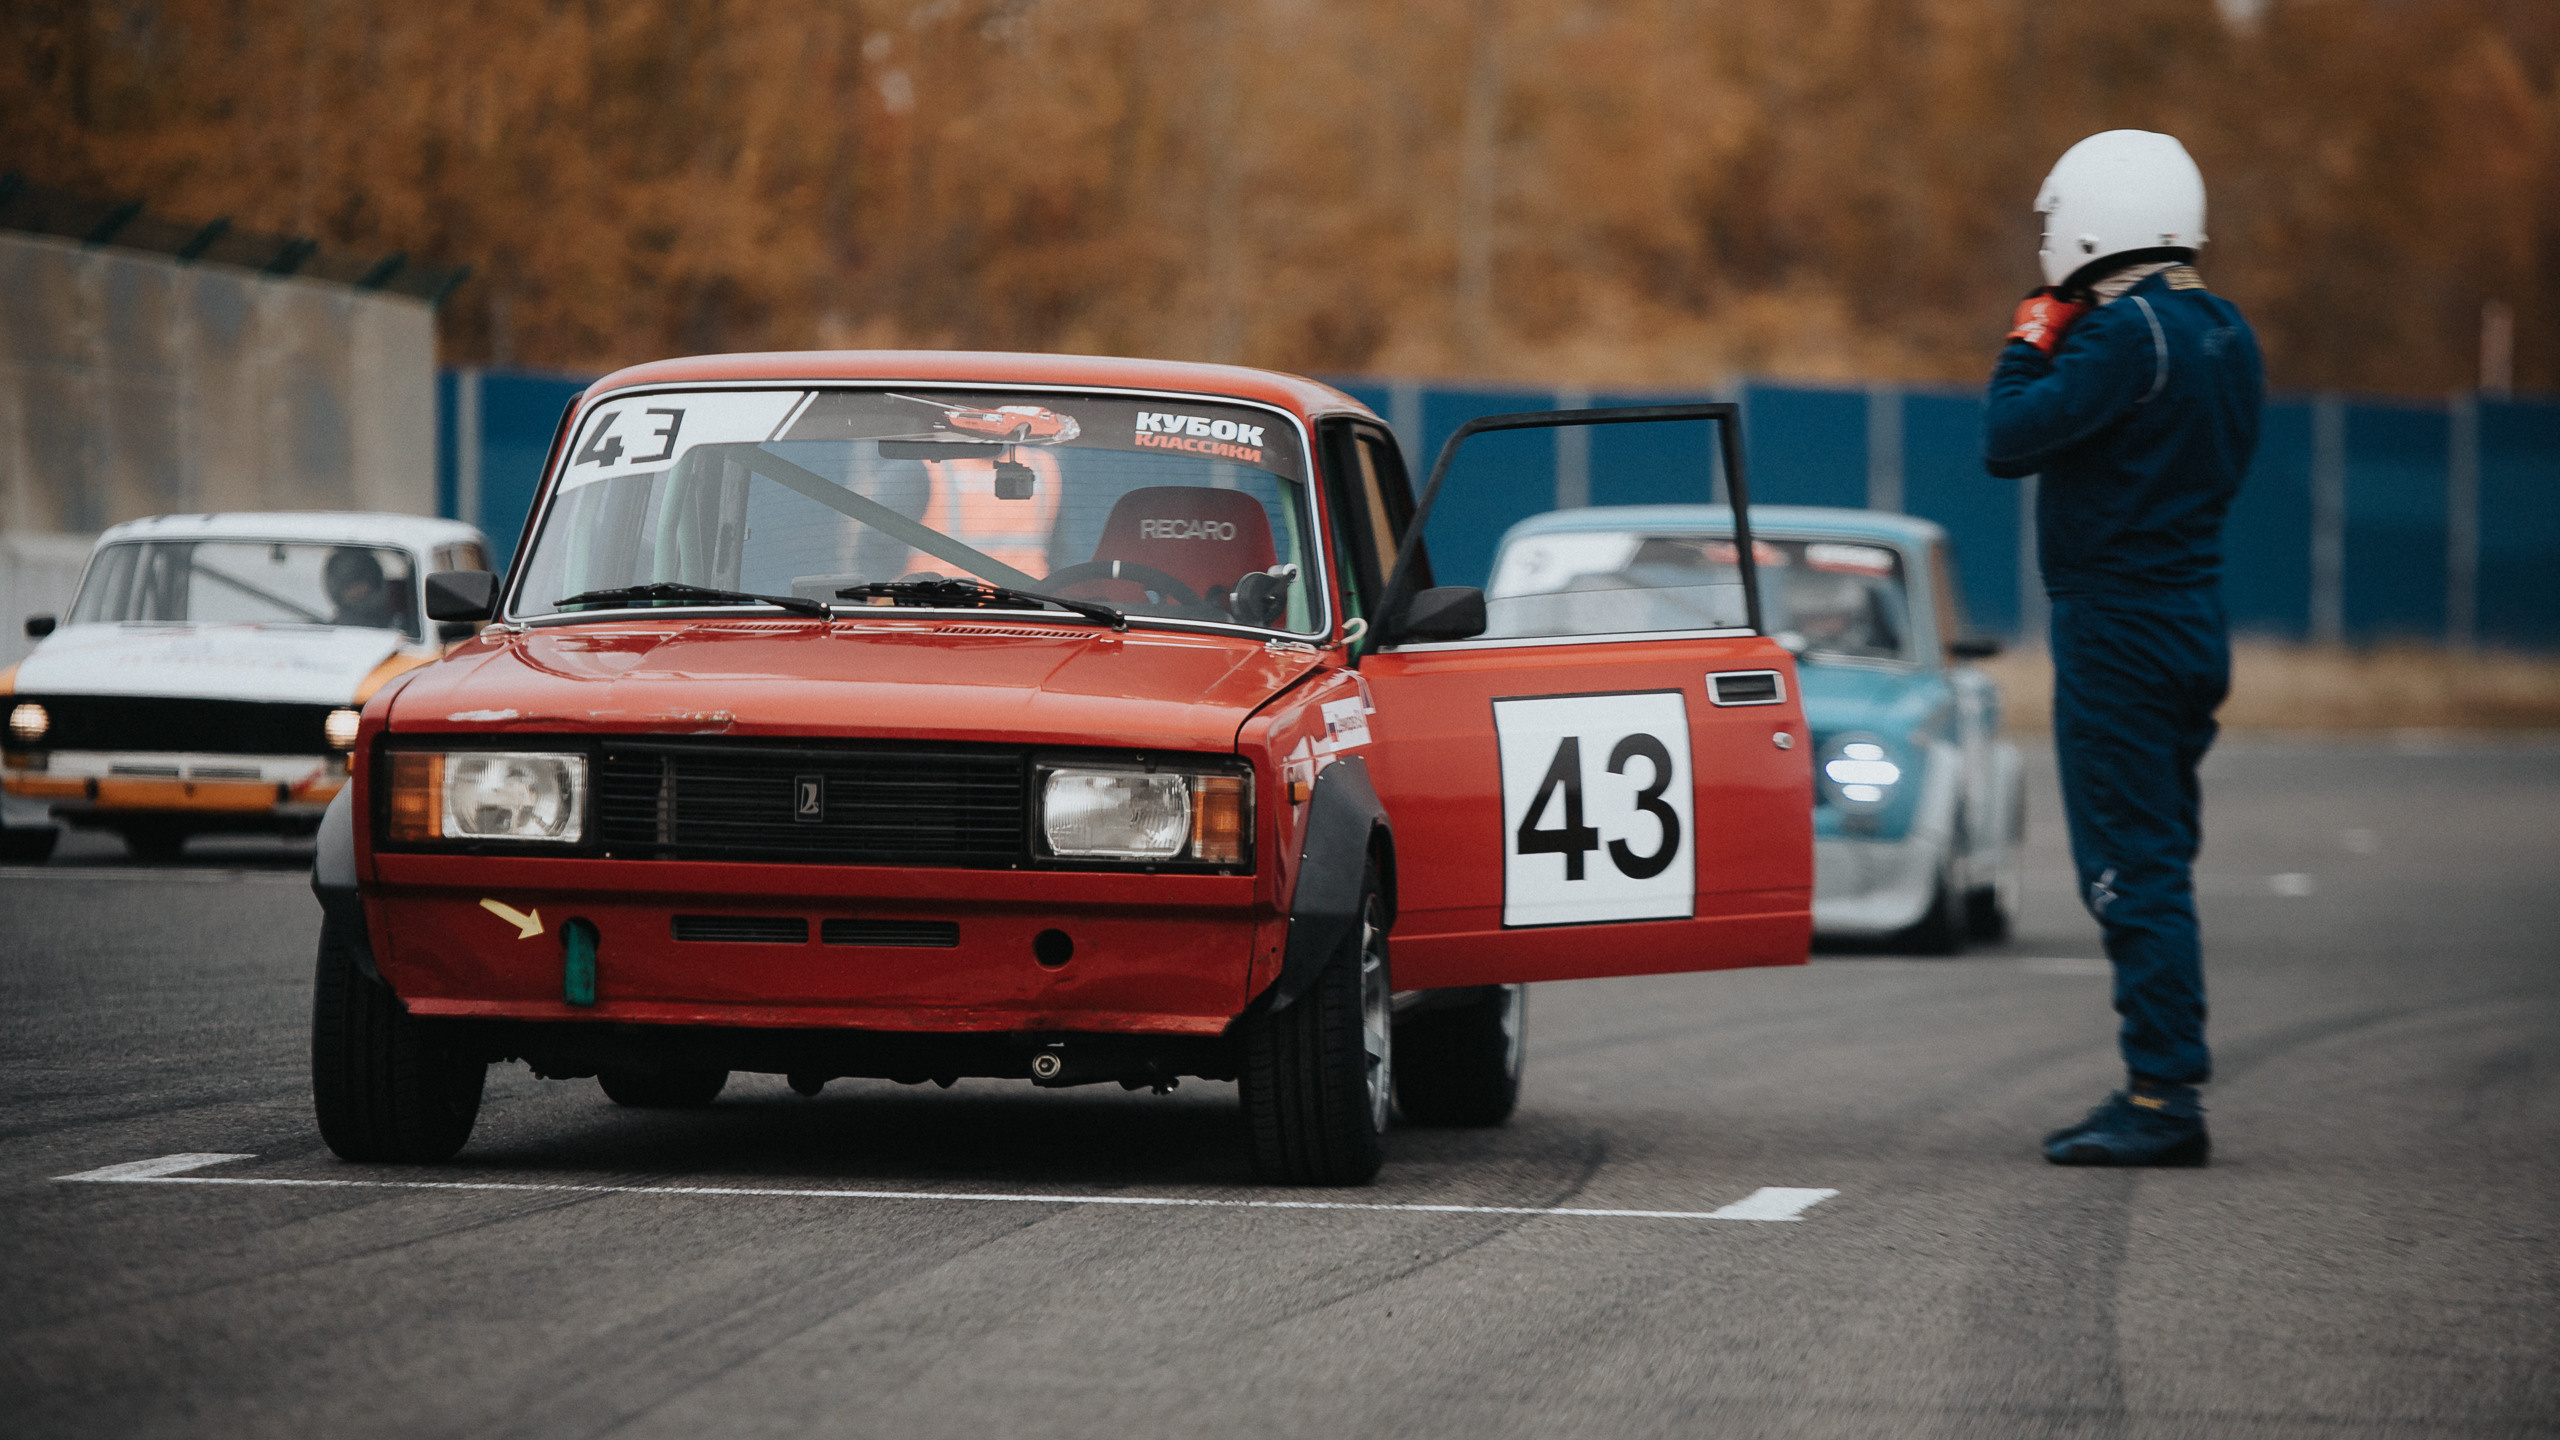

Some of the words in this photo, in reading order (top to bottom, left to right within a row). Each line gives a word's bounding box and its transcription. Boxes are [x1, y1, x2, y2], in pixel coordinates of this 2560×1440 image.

[575, 408, 686, 467] 43
[1135, 412, 1265, 447] КУБОК
[1135, 432, 1262, 463] КЛАССИКИ
[1141, 519, 1236, 541] RECARO
[1517, 732, 1680, 881] 43
